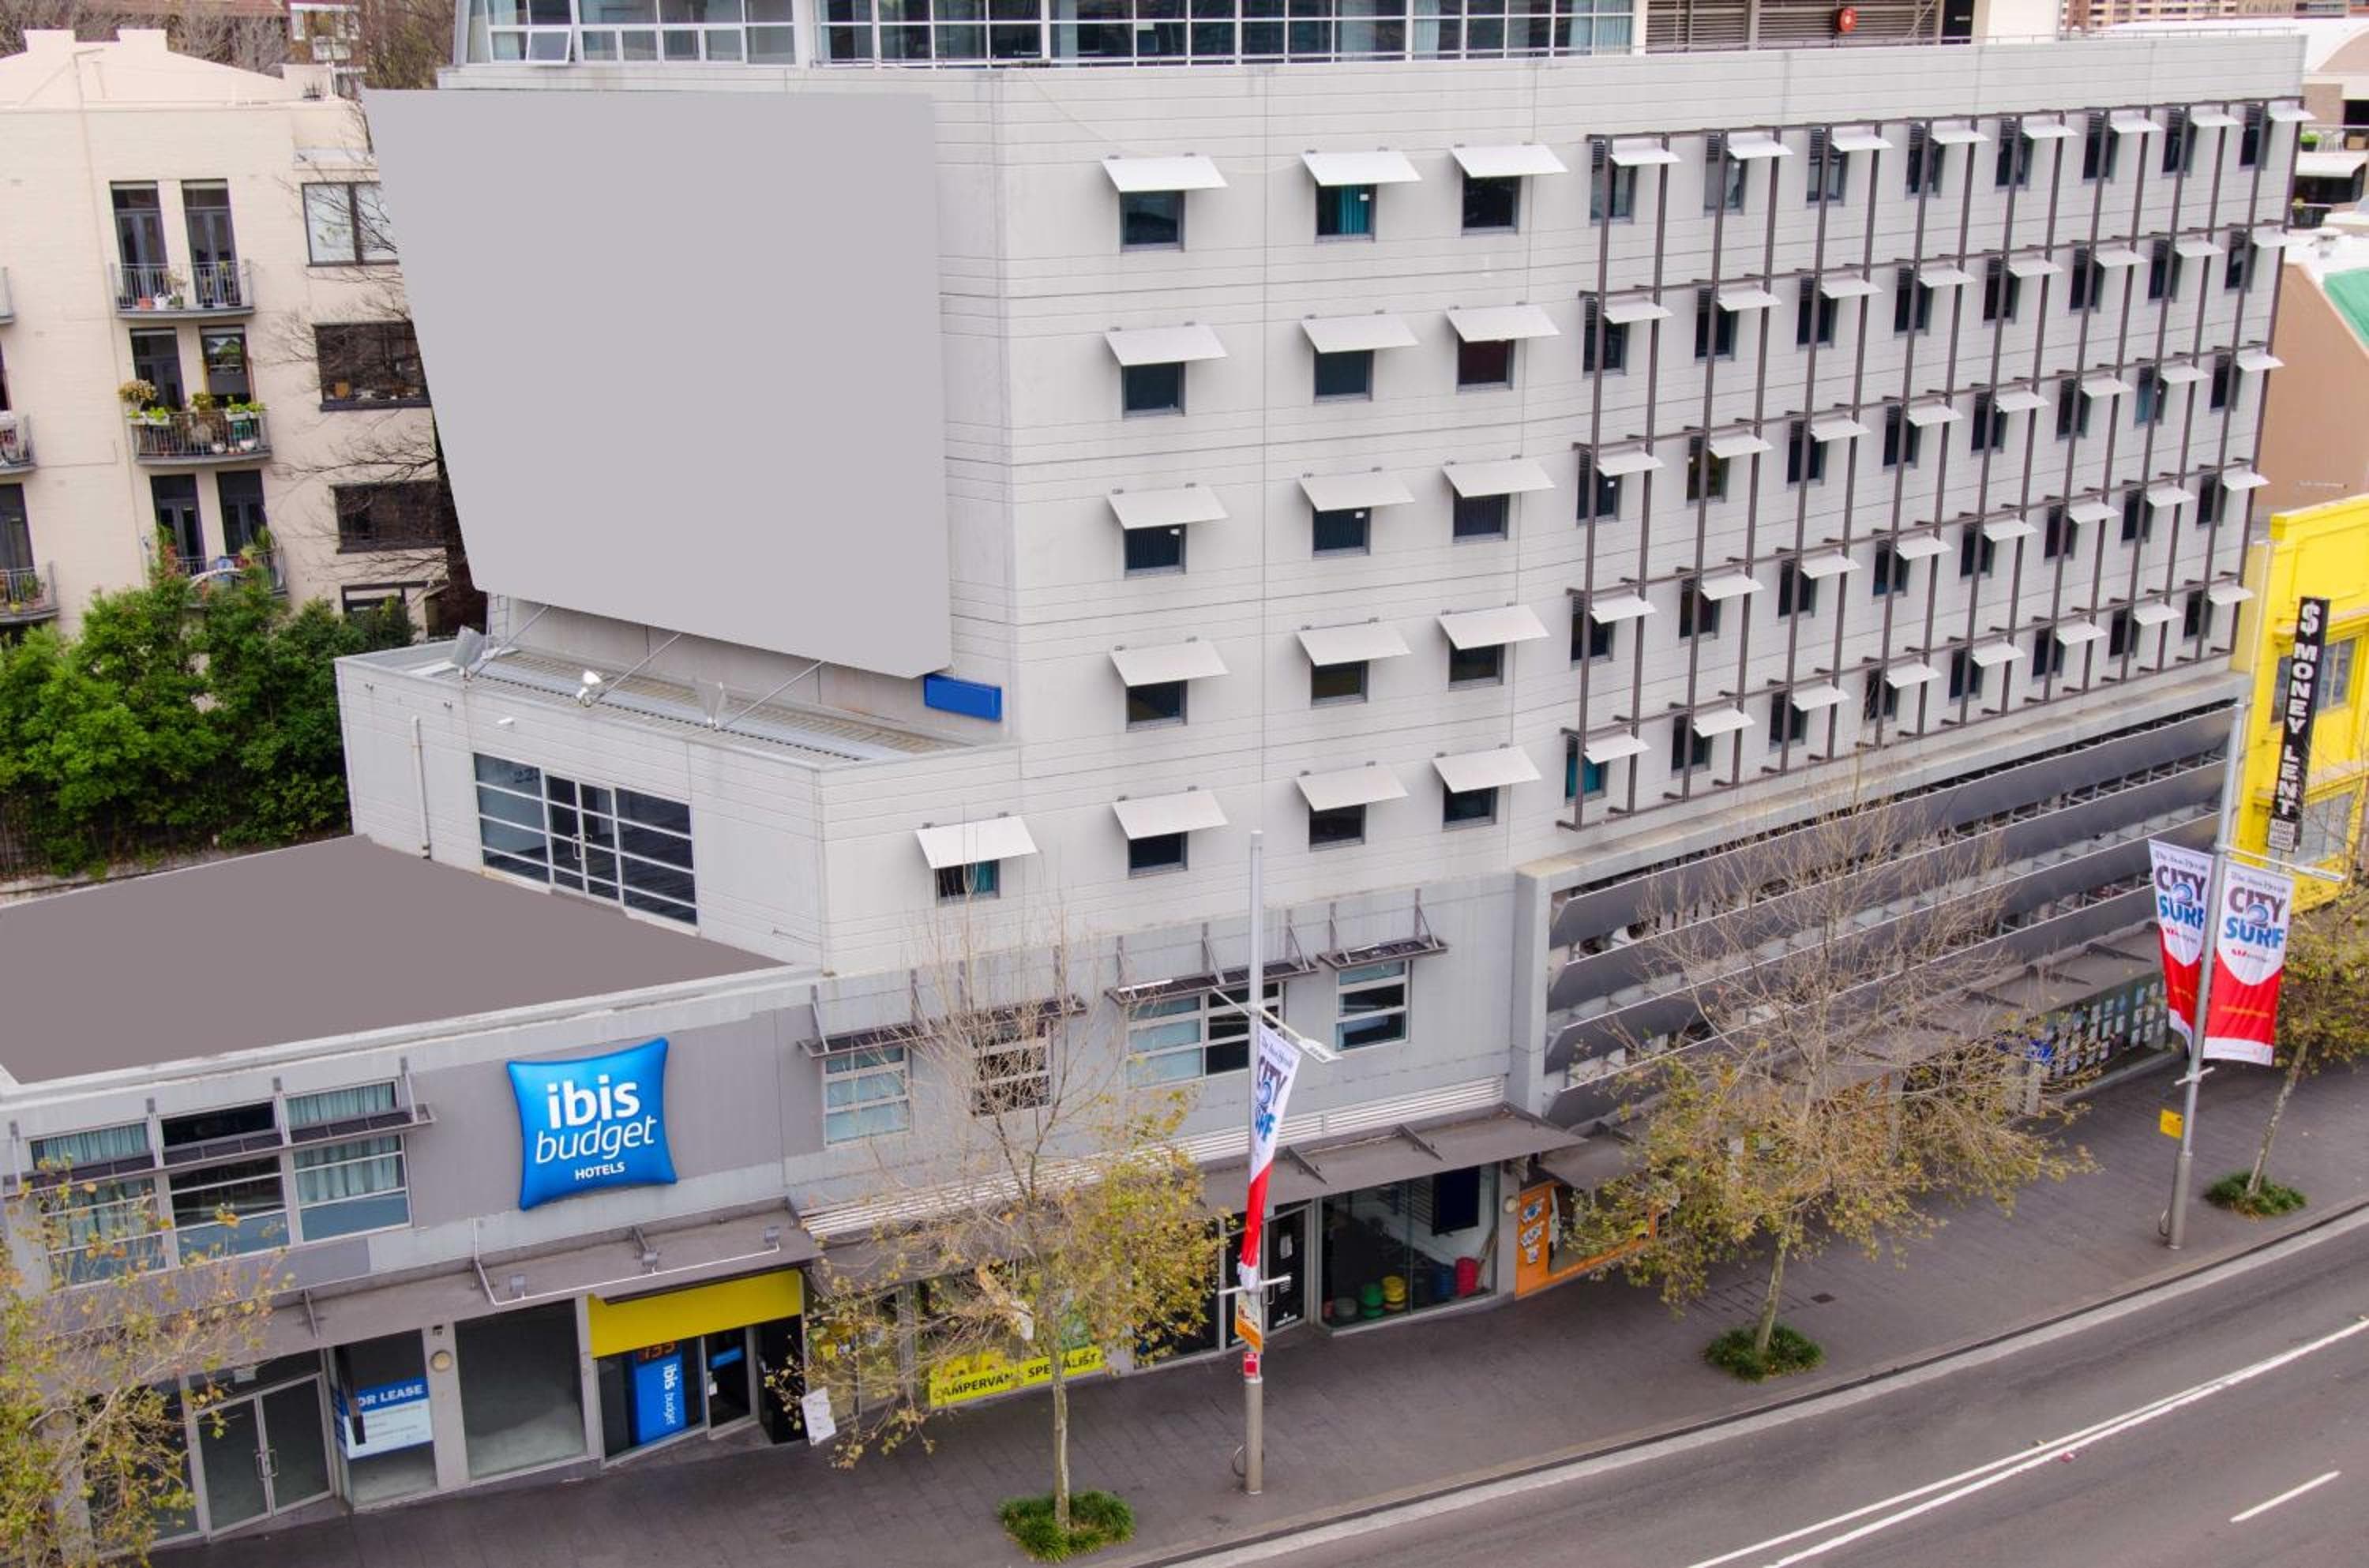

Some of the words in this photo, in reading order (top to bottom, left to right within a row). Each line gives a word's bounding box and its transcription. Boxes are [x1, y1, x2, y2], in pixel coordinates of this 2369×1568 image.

[2287, 642, 2318, 734] MONEY
[2277, 745, 2300, 816] LENT
[2156, 865, 2206, 902] CITY
[2159, 895, 2204, 931] SURF
[2228, 886, 2286, 923] CITY
[2224, 916, 2285, 949] SURF
[546, 1074, 640, 1129] ibis
[535, 1115, 657, 1165] budget
[575, 1161, 625, 1180] HOTELS
[380, 1384, 425, 1403] LEASE
[663, 1364, 678, 1390] ibis
[933, 1372, 1014, 1401] AMPERVAN
[1028, 1353, 1097, 1378] SPEALIST
